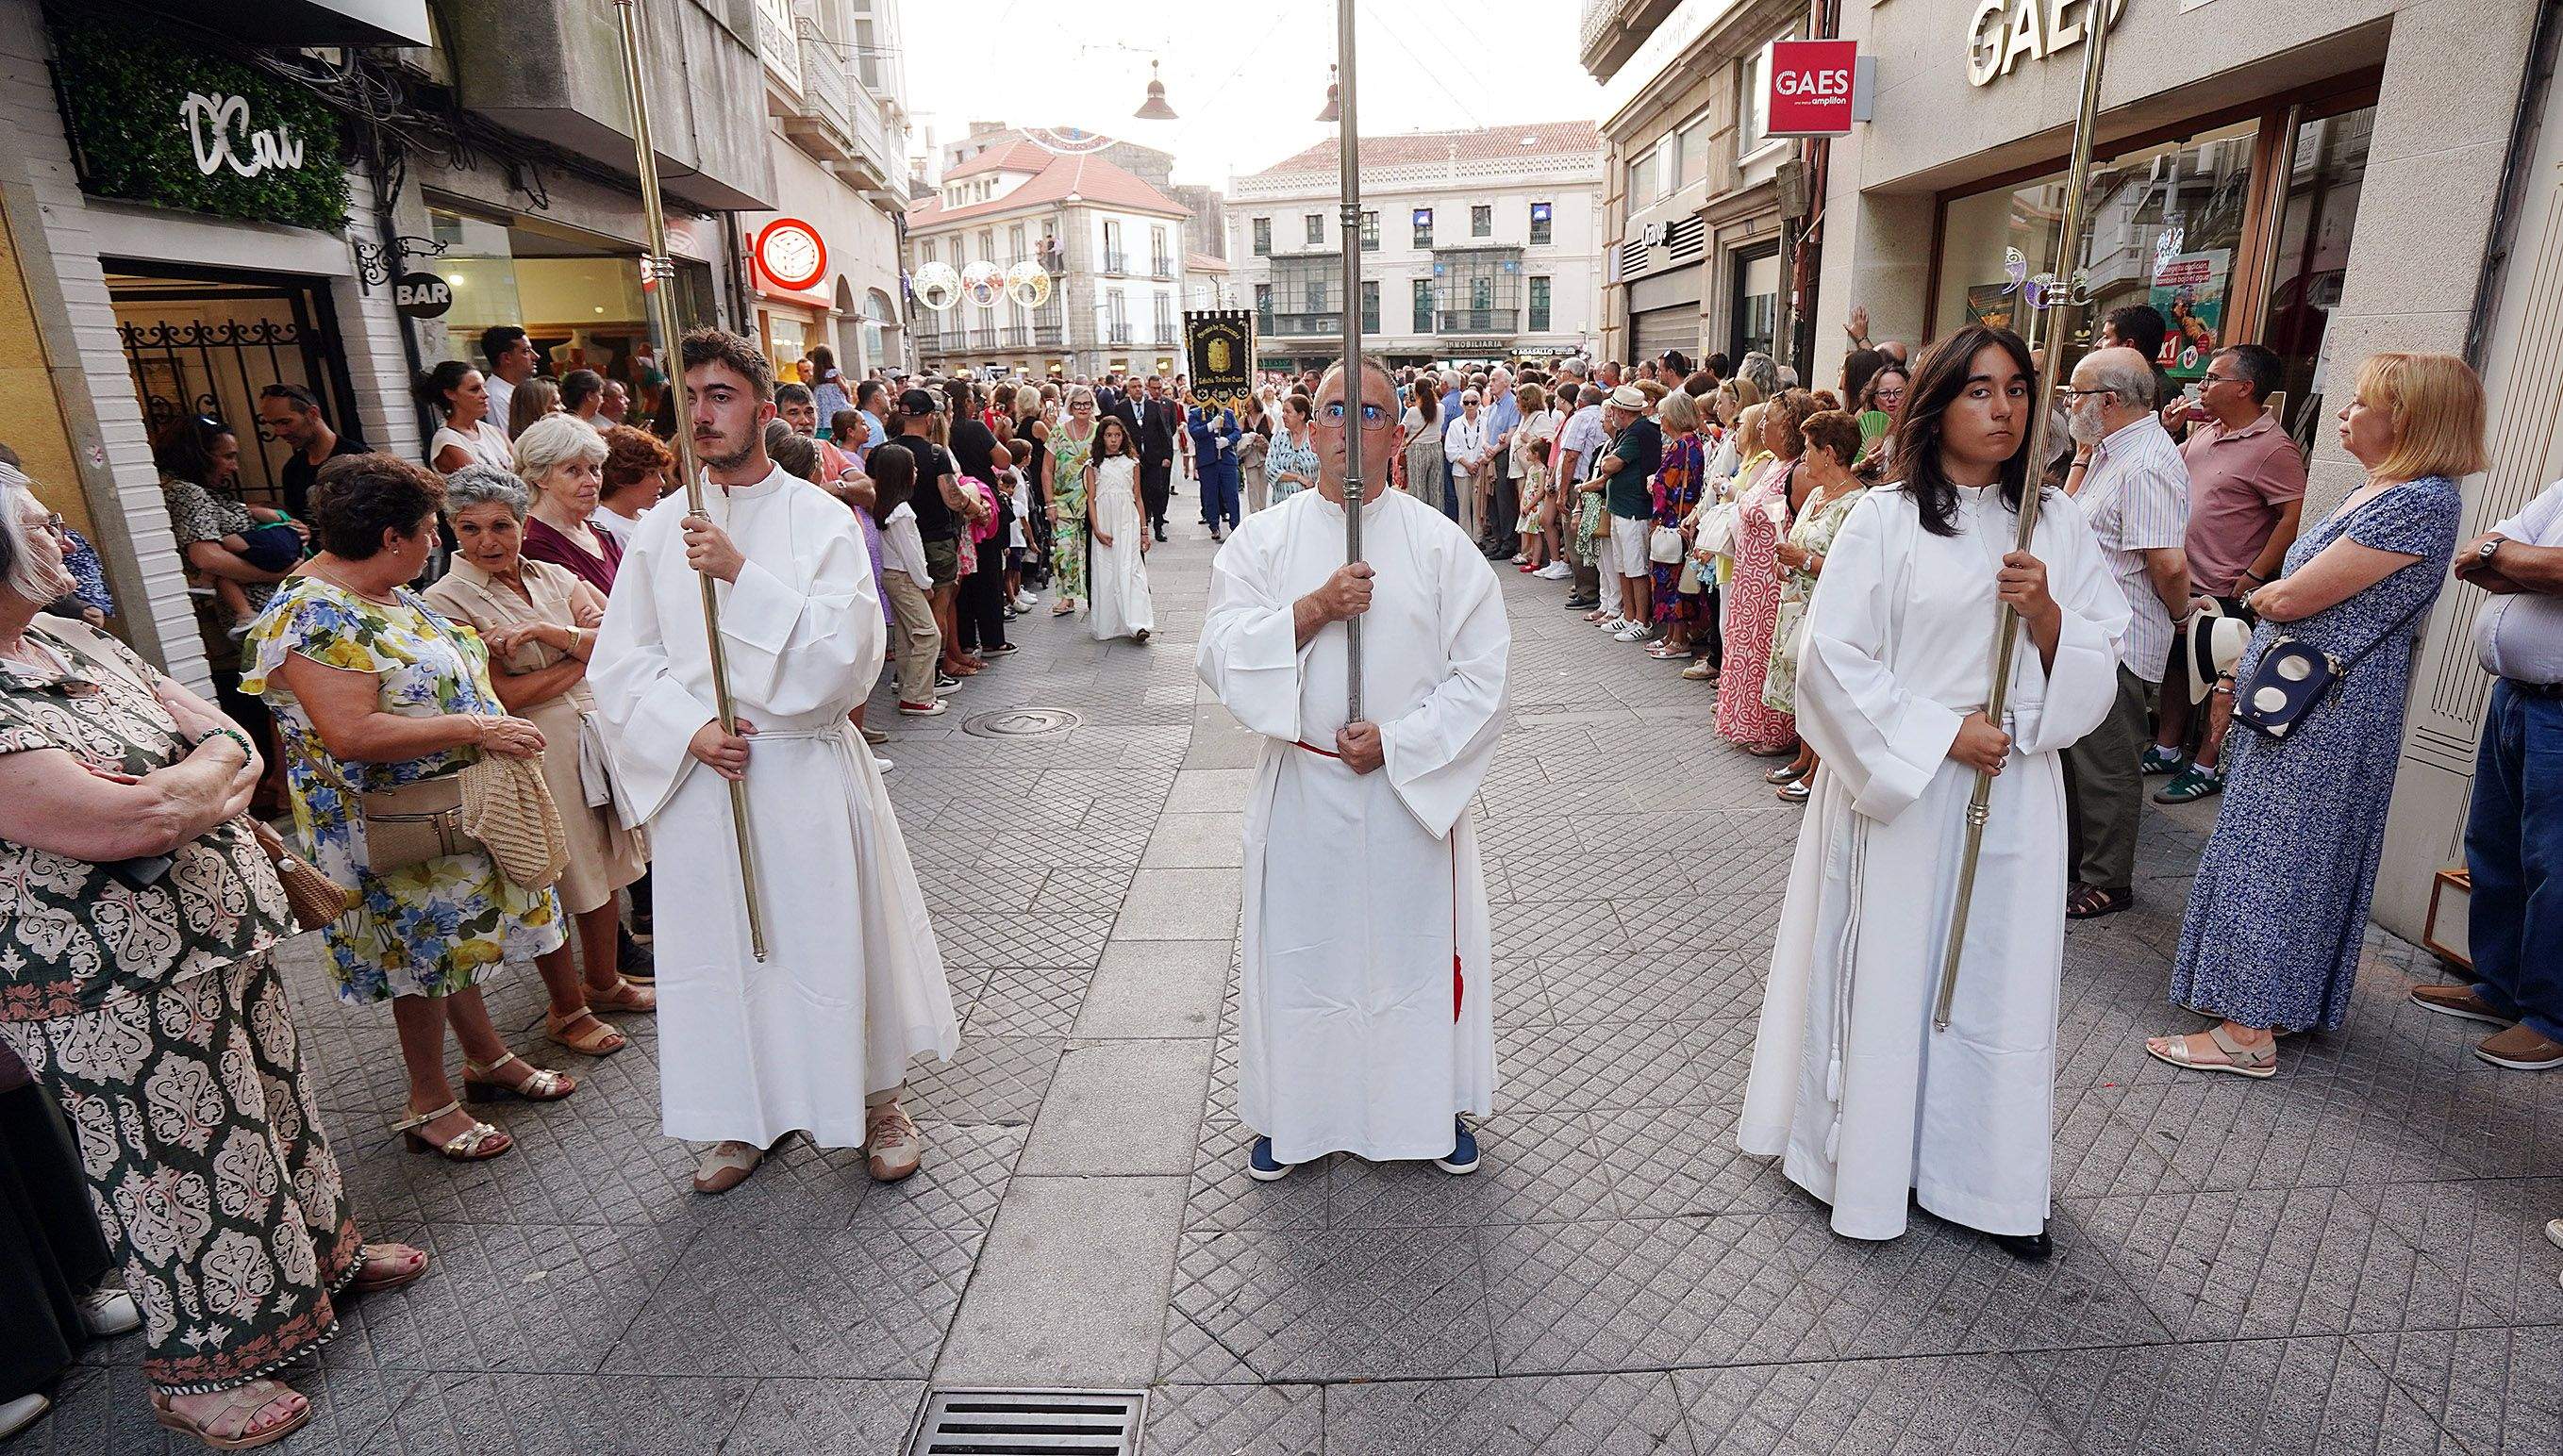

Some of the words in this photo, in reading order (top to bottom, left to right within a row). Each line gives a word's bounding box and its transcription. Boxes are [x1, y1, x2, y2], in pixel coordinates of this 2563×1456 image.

[1775, 69, 1849, 95] GAES
[1811, 96, 1847, 107] amplifon
[1641, 220, 1668, 247] Orange
[396, 283, 450, 306] BAR
[1445, 340, 1503, 349] INMOBILIARIA
[2157, 335, 2178, 358] x1
